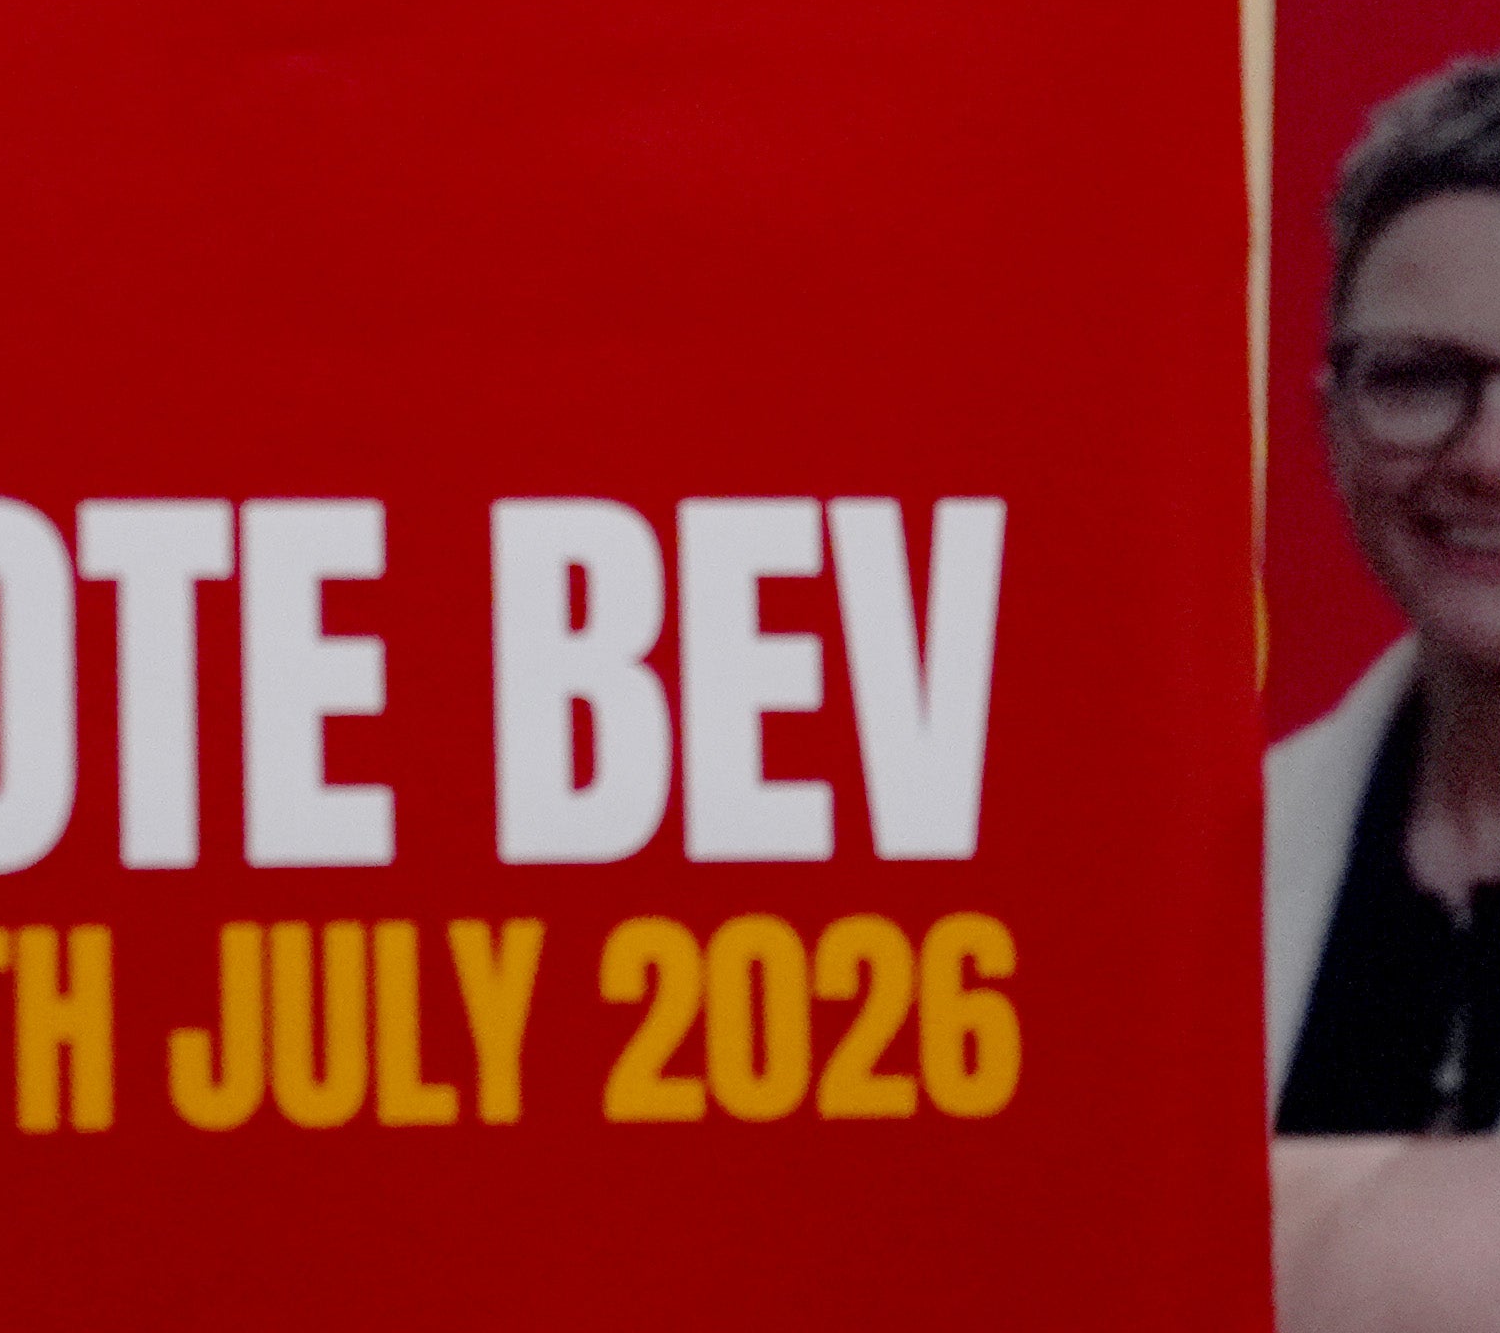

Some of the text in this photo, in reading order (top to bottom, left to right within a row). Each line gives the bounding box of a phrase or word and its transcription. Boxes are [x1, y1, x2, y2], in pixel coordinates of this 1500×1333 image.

[489, 496, 1008, 865] BEV
[168, 918, 545, 1132] JULY
[599, 912, 1022, 1123] 2026
